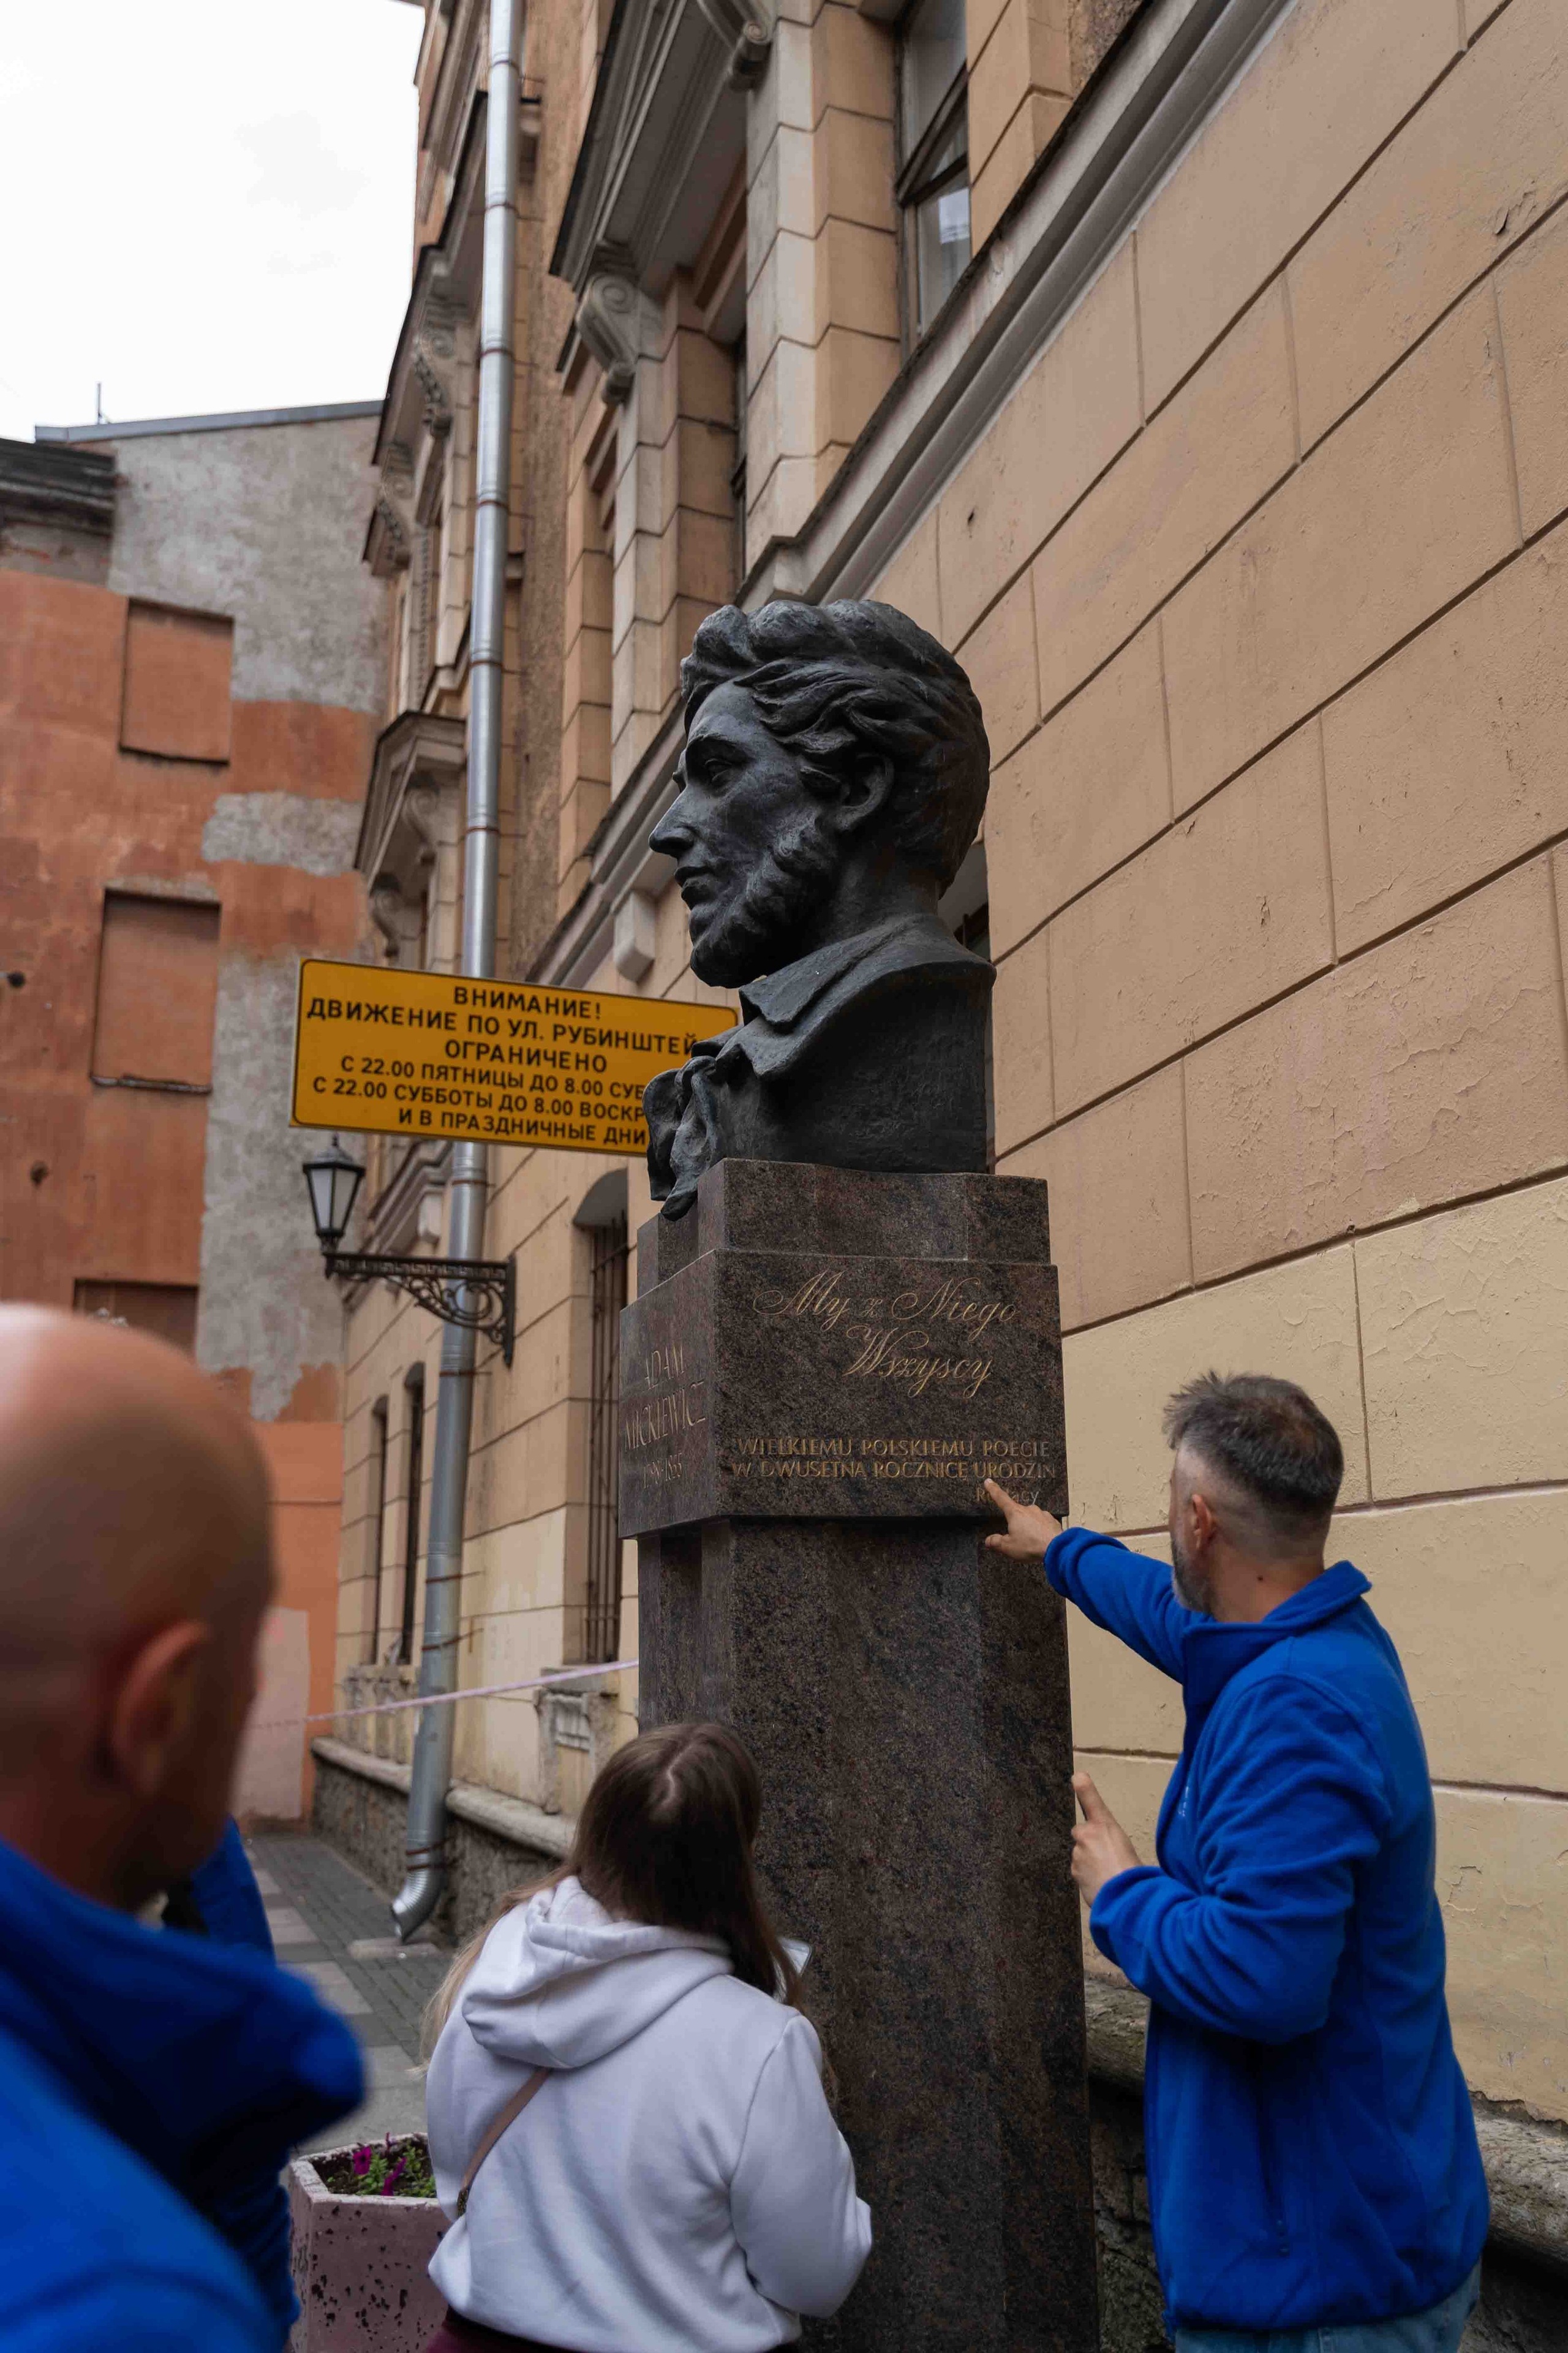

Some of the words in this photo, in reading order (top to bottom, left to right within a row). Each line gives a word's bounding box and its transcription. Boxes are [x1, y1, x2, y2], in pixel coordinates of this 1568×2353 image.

[454, 986, 601, 1019] ВНИМАНИЕ!
[307, 997, 458, 1030] ДВИЖЕНИЕ
[467, 1014, 500, 1035] ПО
[508, 1018, 544, 1040] УЛ.
[552, 1023, 701, 1056] РУБИНШТЕЙ
[445, 1040, 607, 1073] ОГРАНИЧЕНО
[341, 1055, 354, 1072] С
[361, 1057, 415, 1078] 22.00
[421, 1063, 524, 1090] ПЯТНИЦЫ
[529, 1074, 558, 1093] ДО
[564, 1078, 603, 1097] 8.00
[610, 1081, 644, 1100] СУБ
[312, 1076, 326, 1093] С
[333, 1078, 387, 1100] 22.00
[394, 1084, 492, 1108] СУББОТЫ
[498, 1093, 527, 1112] ДО
[534, 1097, 573, 1116] 8.00
[579, 1102, 644, 1122] ВОСКР
[399, 1108, 412, 1125] И
[420, 1109, 432, 1127] В
[441, 1111, 596, 1141] ПРАЗДНИЧНЫЕ
[603, 1126, 646, 1146] ДНИ
[753, 1269, 851, 1332] My
[891, 1277, 1017, 1342] Niego
[643, 1345, 685, 1391] ADAM
[842, 1324, 993, 1399] Wszyscy
[736, 1437, 853, 1456] WIELKIEMU
[861, 1438, 973, 1457] POLSKIEMU
[982, 1440, 1050, 1457] POECIE
[731, 1461, 752, 1478] W
[760, 1460, 867, 1478] DWUSETNA
[973, 1462, 1055, 1479] URODZIN
[976, 1481, 1041, 1505] Racy
